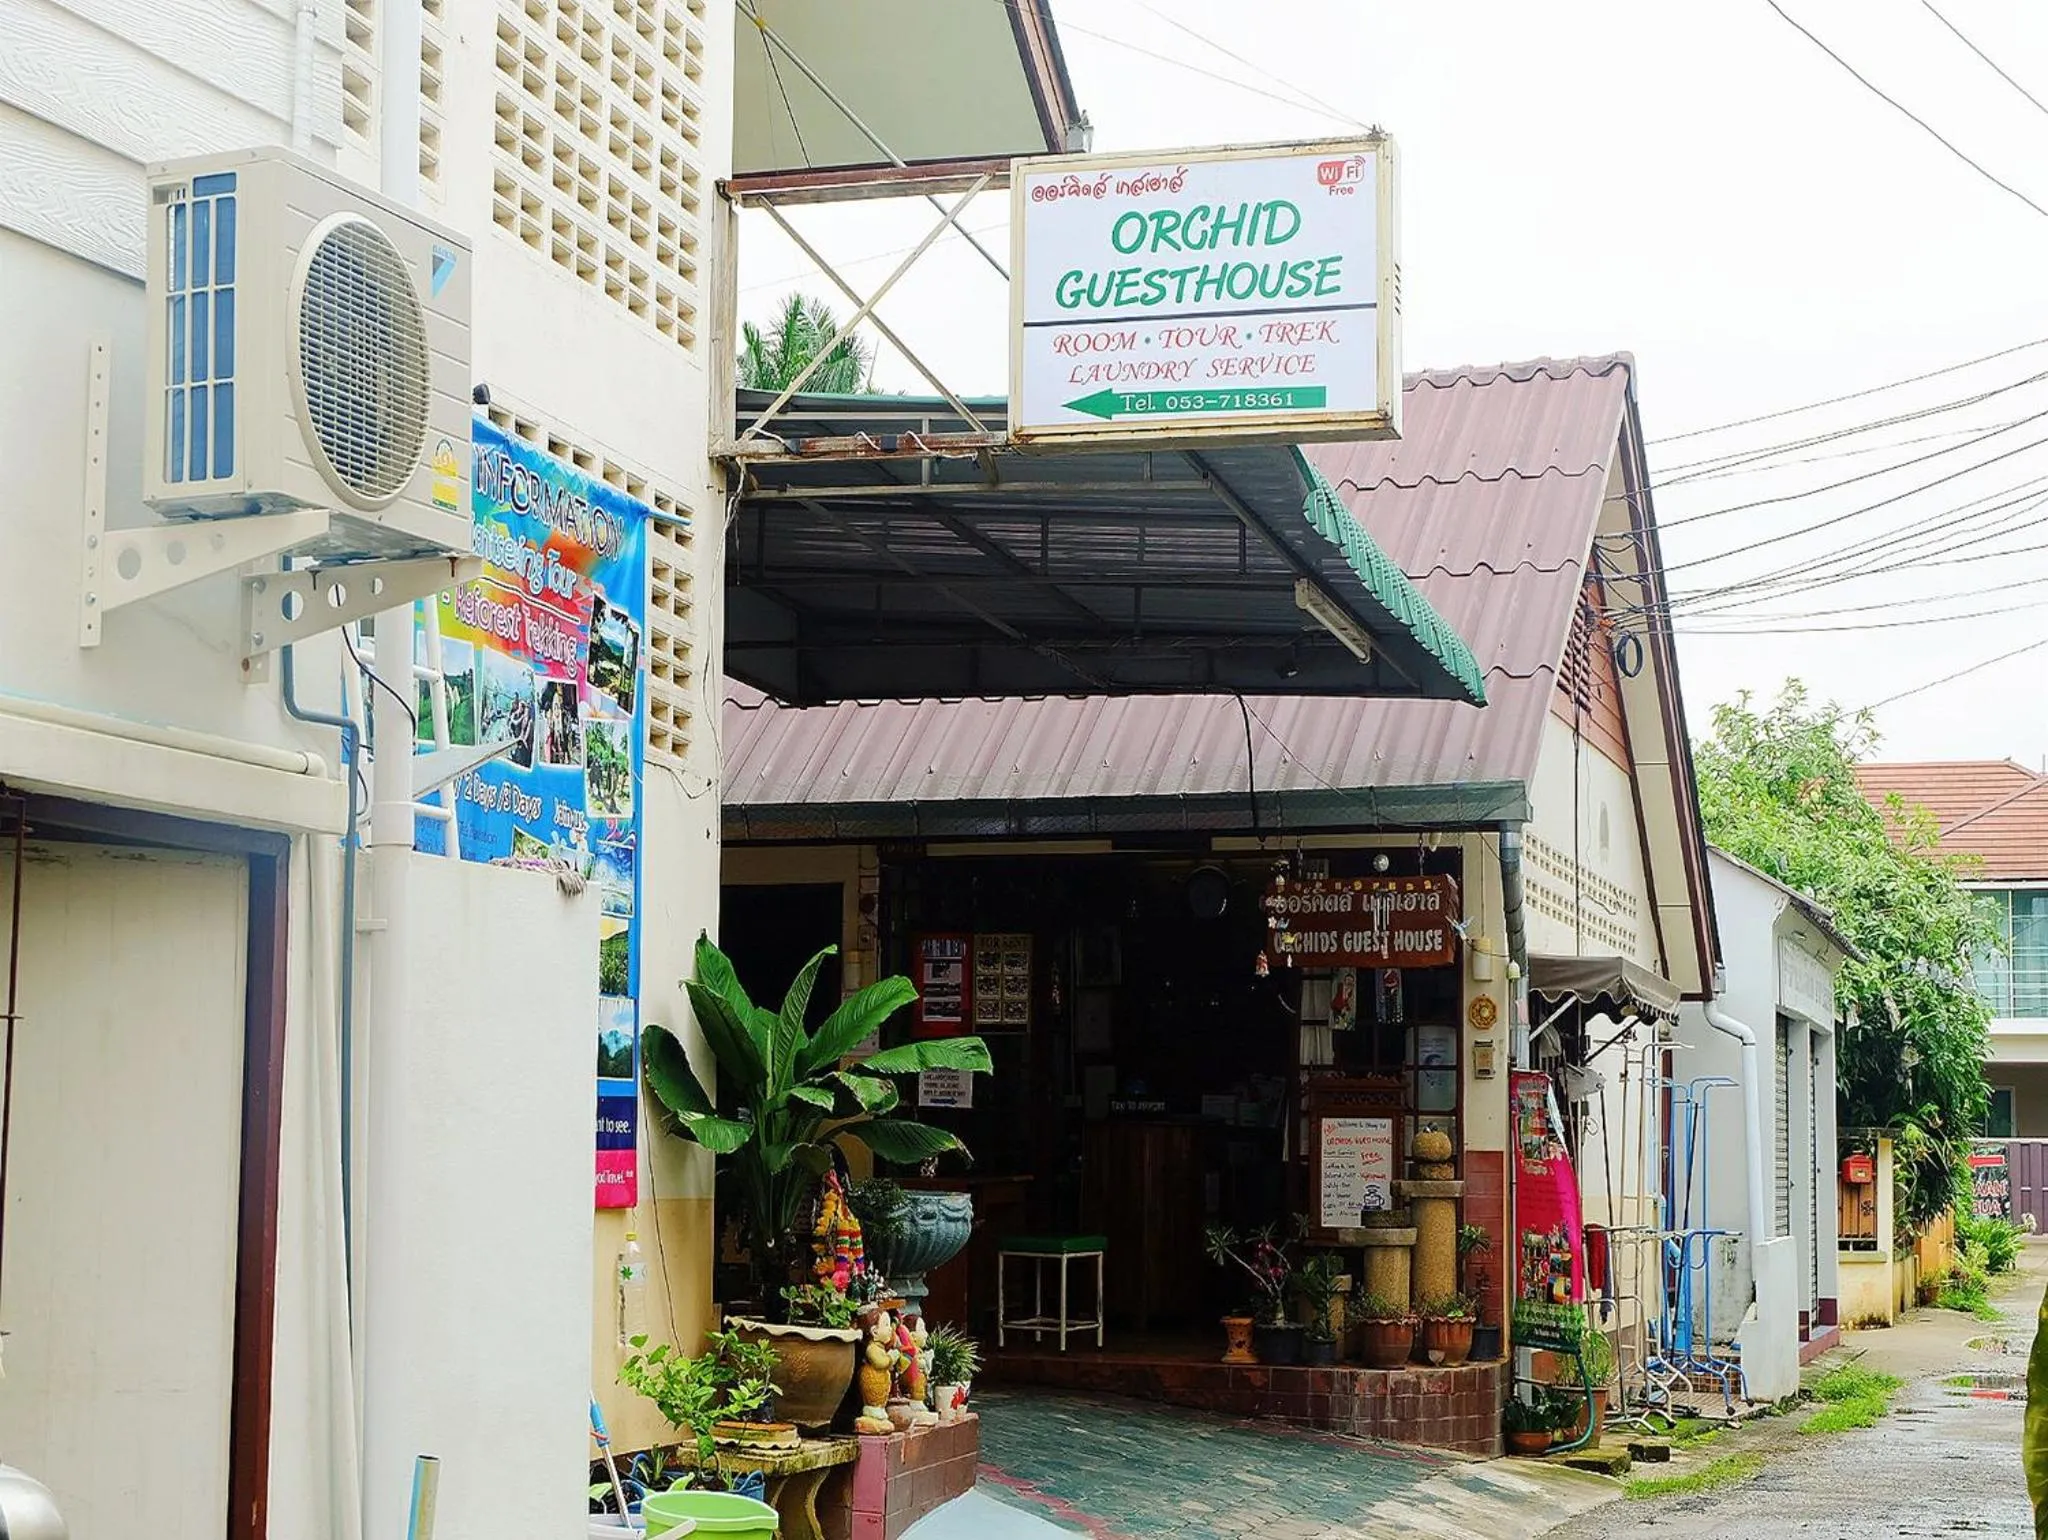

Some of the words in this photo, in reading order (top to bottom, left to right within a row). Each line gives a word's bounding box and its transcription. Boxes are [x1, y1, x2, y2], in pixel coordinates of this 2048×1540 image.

[1329, 185, 1354, 196] Free
[1111, 200, 1301, 254] ORCHID
[1055, 255, 1343, 309] GUESTHOUSE
[1053, 330, 1136, 356] ROOM
[1159, 325, 1242, 350] TOUR
[1258, 320, 1340, 347] TREK
[1068, 358, 1198, 384] LAUNDRY
[1206, 353, 1316, 378] SERVICE
[1120, 394, 1155, 411] Tel.
[1166, 393, 1293, 410] 053-718361
[473, 442, 624, 561] INFORMATION
[512, 785, 542, 824] Days
[1343, 930, 1390, 953] GUEST
[1395, 930, 1443, 951] HOUSE
